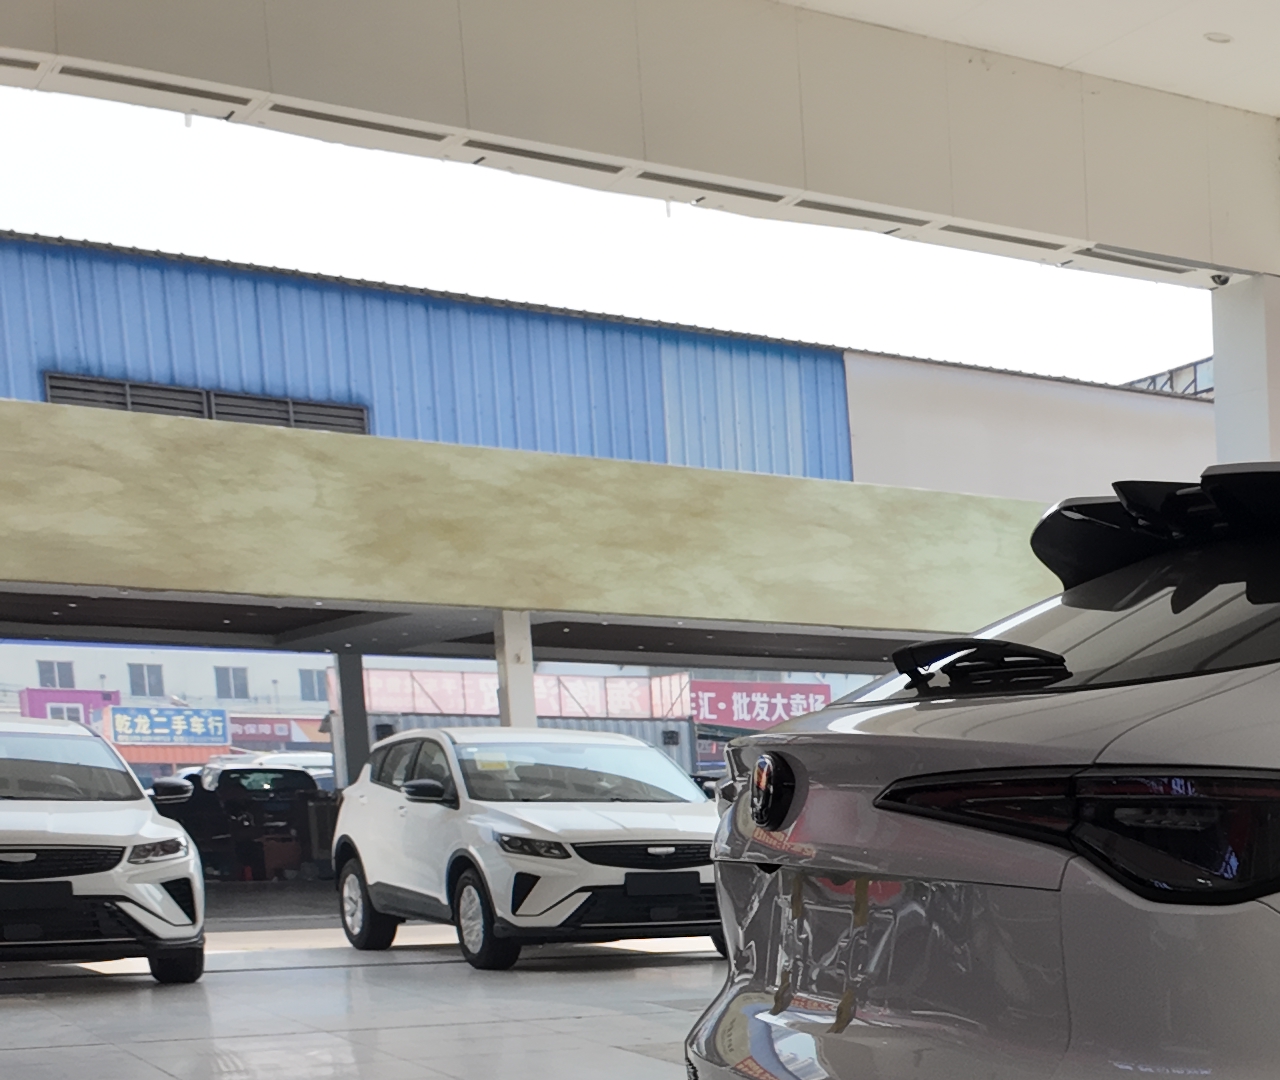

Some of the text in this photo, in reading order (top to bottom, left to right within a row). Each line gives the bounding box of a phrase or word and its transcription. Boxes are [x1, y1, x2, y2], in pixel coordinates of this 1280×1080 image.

[114, 713, 224, 736] 乾龙二手车行
